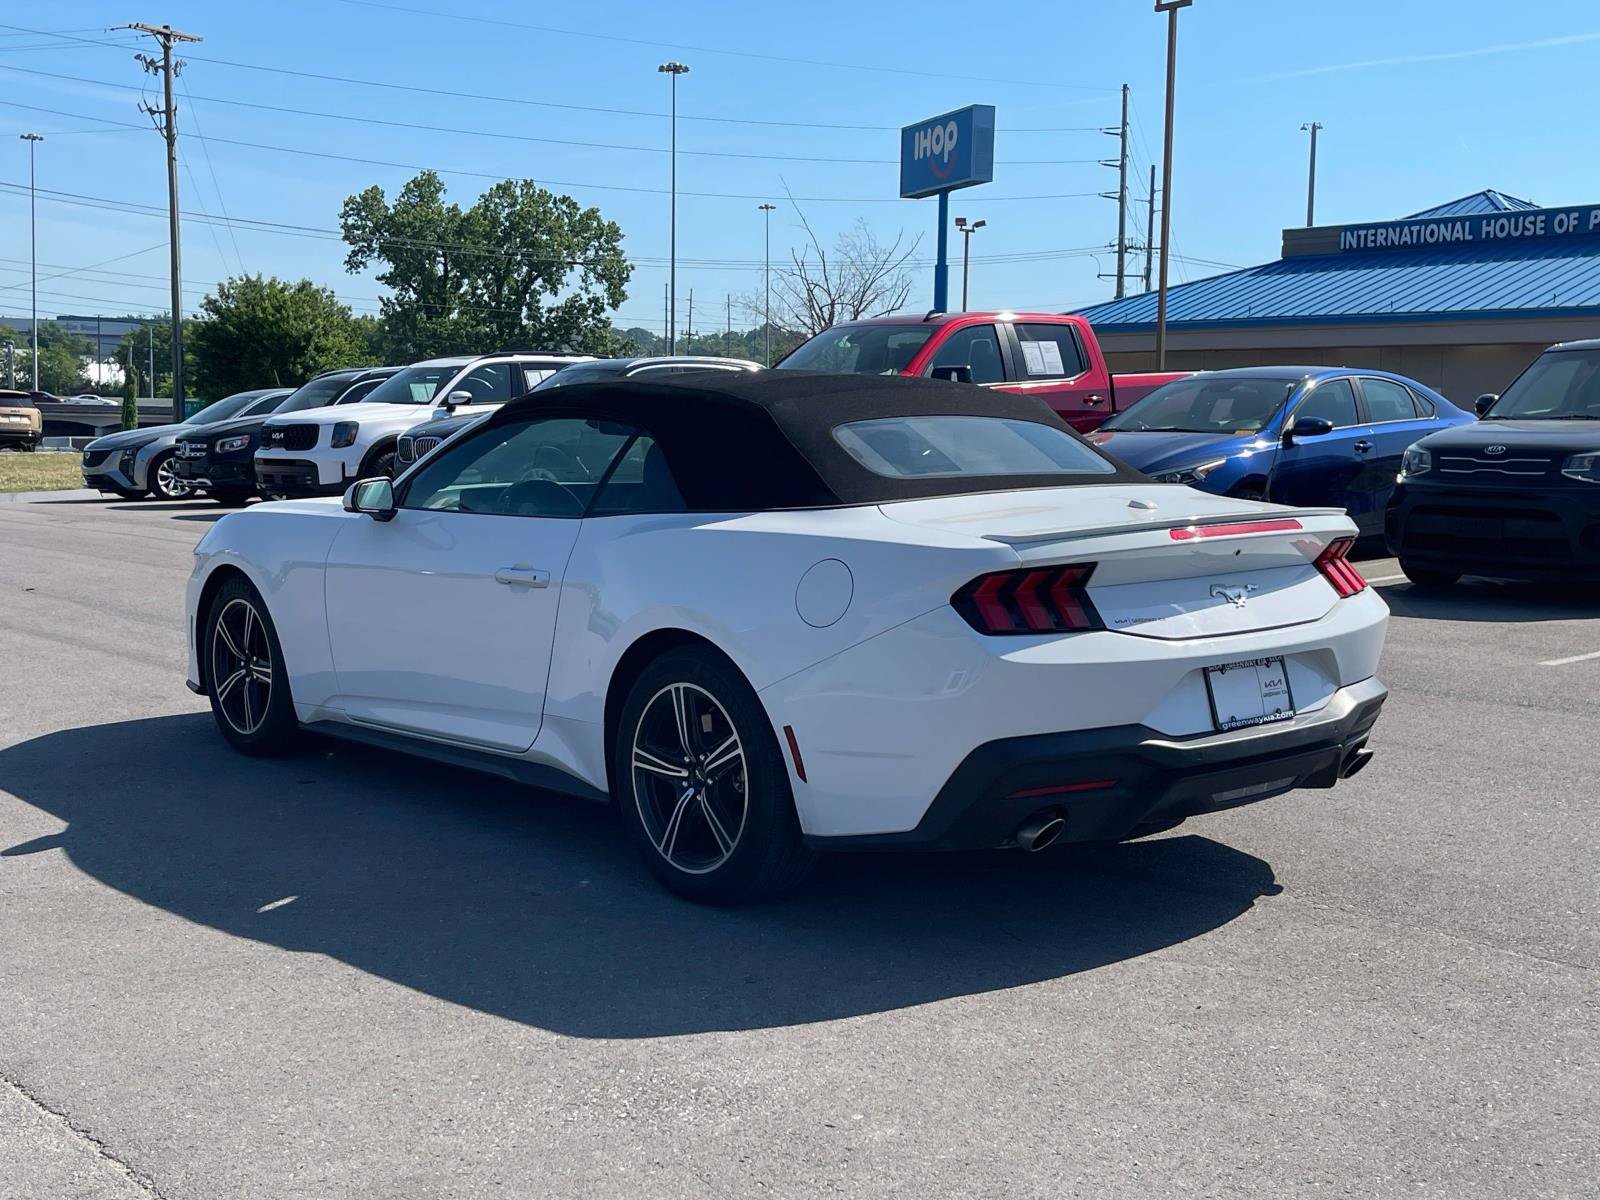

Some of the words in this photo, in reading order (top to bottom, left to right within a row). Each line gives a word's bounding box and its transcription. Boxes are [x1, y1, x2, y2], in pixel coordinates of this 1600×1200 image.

[914, 121, 958, 163] IHOP
[1340, 221, 1473, 249] INTERNATIONAL
[1481, 215, 1546, 239] HOUSE
[1553, 212, 1579, 233] OF
